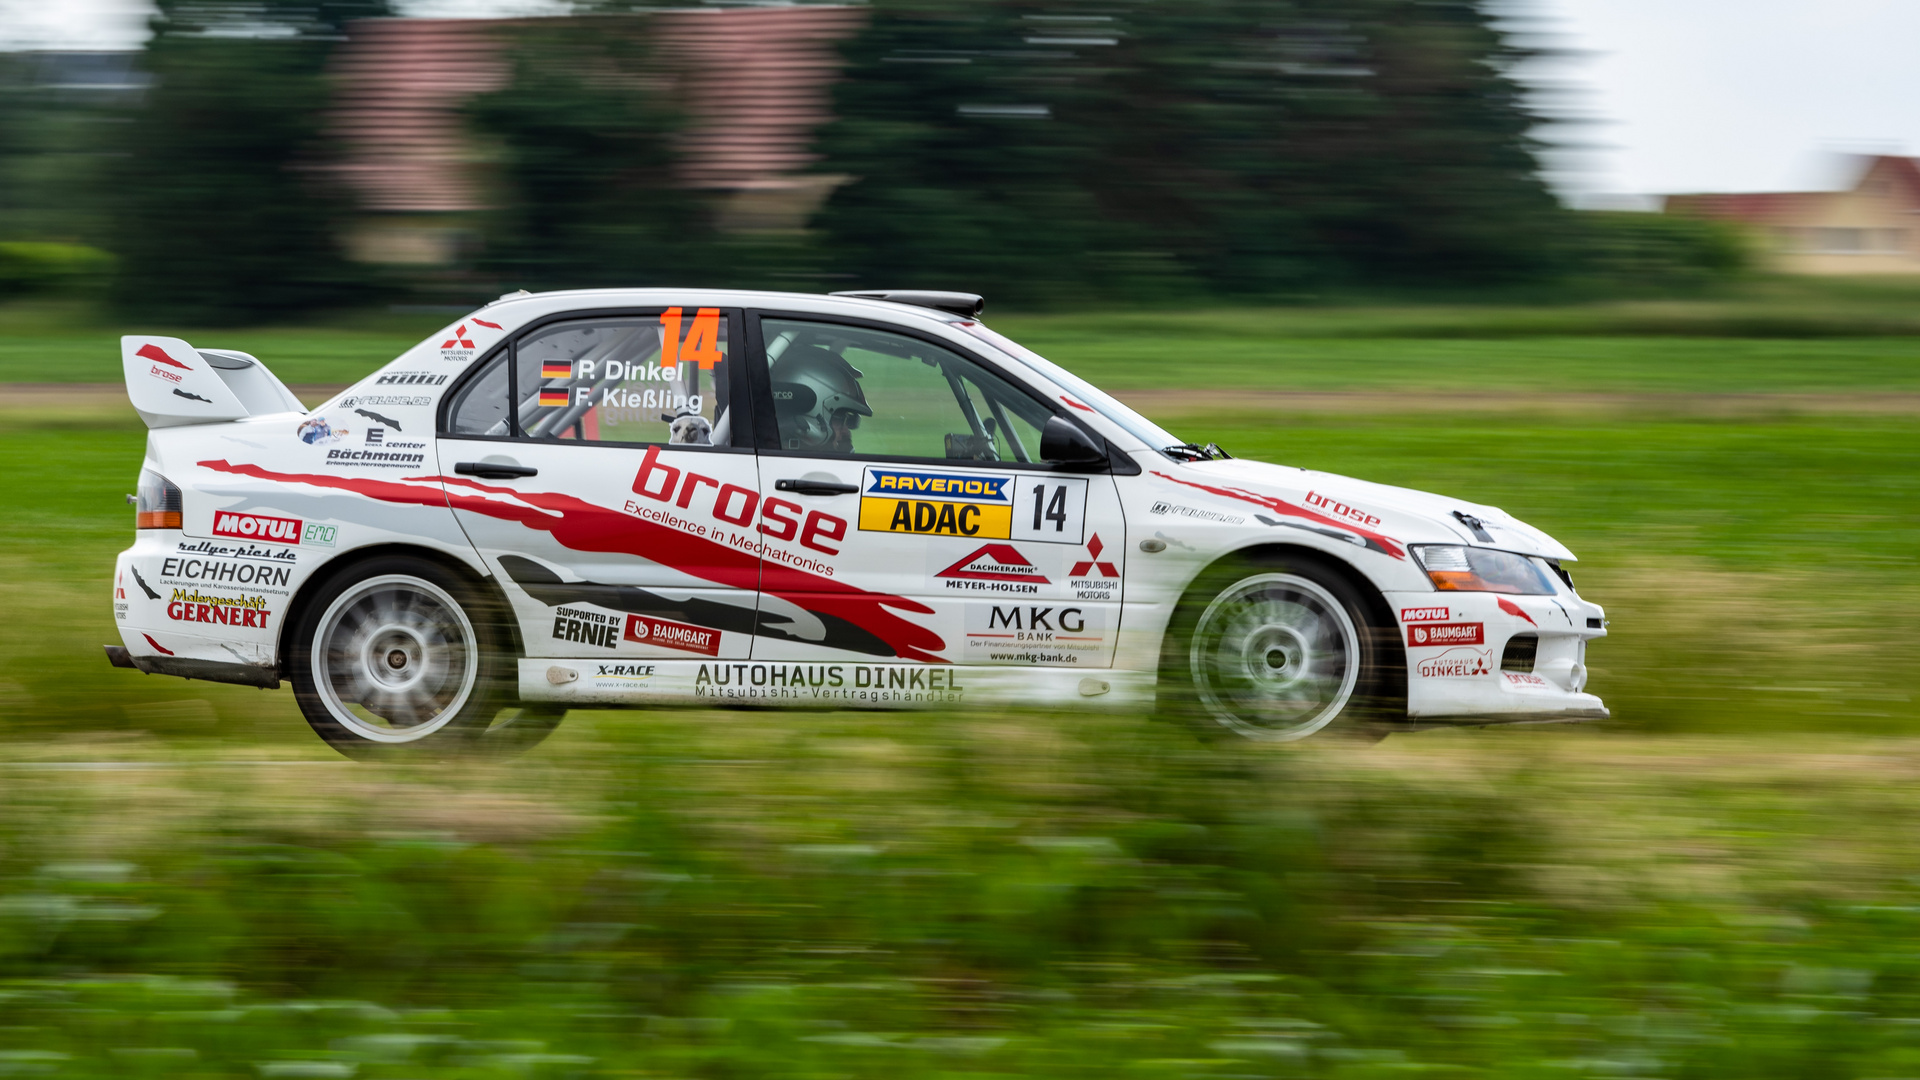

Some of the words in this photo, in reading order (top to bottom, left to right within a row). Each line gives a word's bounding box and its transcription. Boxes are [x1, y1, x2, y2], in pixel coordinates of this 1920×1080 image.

[660, 306, 723, 370] 14
[151, 364, 183, 383] brose
[577, 359, 595, 380] P.
[605, 360, 684, 382] Dinkel
[575, 387, 593, 406] F.
[602, 387, 703, 414] Kießling
[386, 441, 426, 449] center
[327, 448, 424, 463] Bächmann
[631, 444, 847, 556] brose
[1032, 483, 1067, 532] 14
[1304, 490, 1381, 528] brose
[216, 514, 298, 540] MOTUL
[889, 501, 981, 536] ADAC
[624, 500, 707, 536] Excellence
[710, 527, 724, 542] in
[729, 533, 834, 576] Mechatronics
[178, 542, 297, 561] rallye-pics.de
[161, 558, 292, 587] EICHHORN
[970, 563, 1034, 574] DACHKERAMIK
[159, 579, 199, 588] Lackierungen
[213, 583, 290, 597] Karosserieinstandsetzung
[946, 580, 1038, 594] MEYER-HOLSEN
[1071, 580, 1118, 589] MITSUBISHI
[169, 588, 267, 611] Malergeschäft
[1077, 591, 1110, 599] MOTORS
[167, 601, 271, 629] GERNERT
[556, 606, 606, 624] SUPPORTED
[609, 616, 621, 626] BY
[988, 606, 1085, 633] MKG
[1403, 609, 1448, 621] MOTUL
[552, 616, 620, 649] ERNIE
[653, 623, 712, 646] BAUMGART
[1017, 632, 1053, 641] BANK
[1430, 626, 1478, 639] BAUMGART
[970, 640, 982, 648] Der
[984, 641, 1052, 650] Finanzierungspartner
[1067, 644, 1100, 652] Mitsubishi
[990, 652, 1078, 664] www.mkg-bank.de
[597, 665, 655, 676] X-RACE
[695, 663, 844, 687] AUTOHAUS
[855, 666, 963, 692] DINKEL
[1423, 665, 1470, 677] DINKEL
[695, 684, 964, 704] Mitsubishi-Vertragshändler
